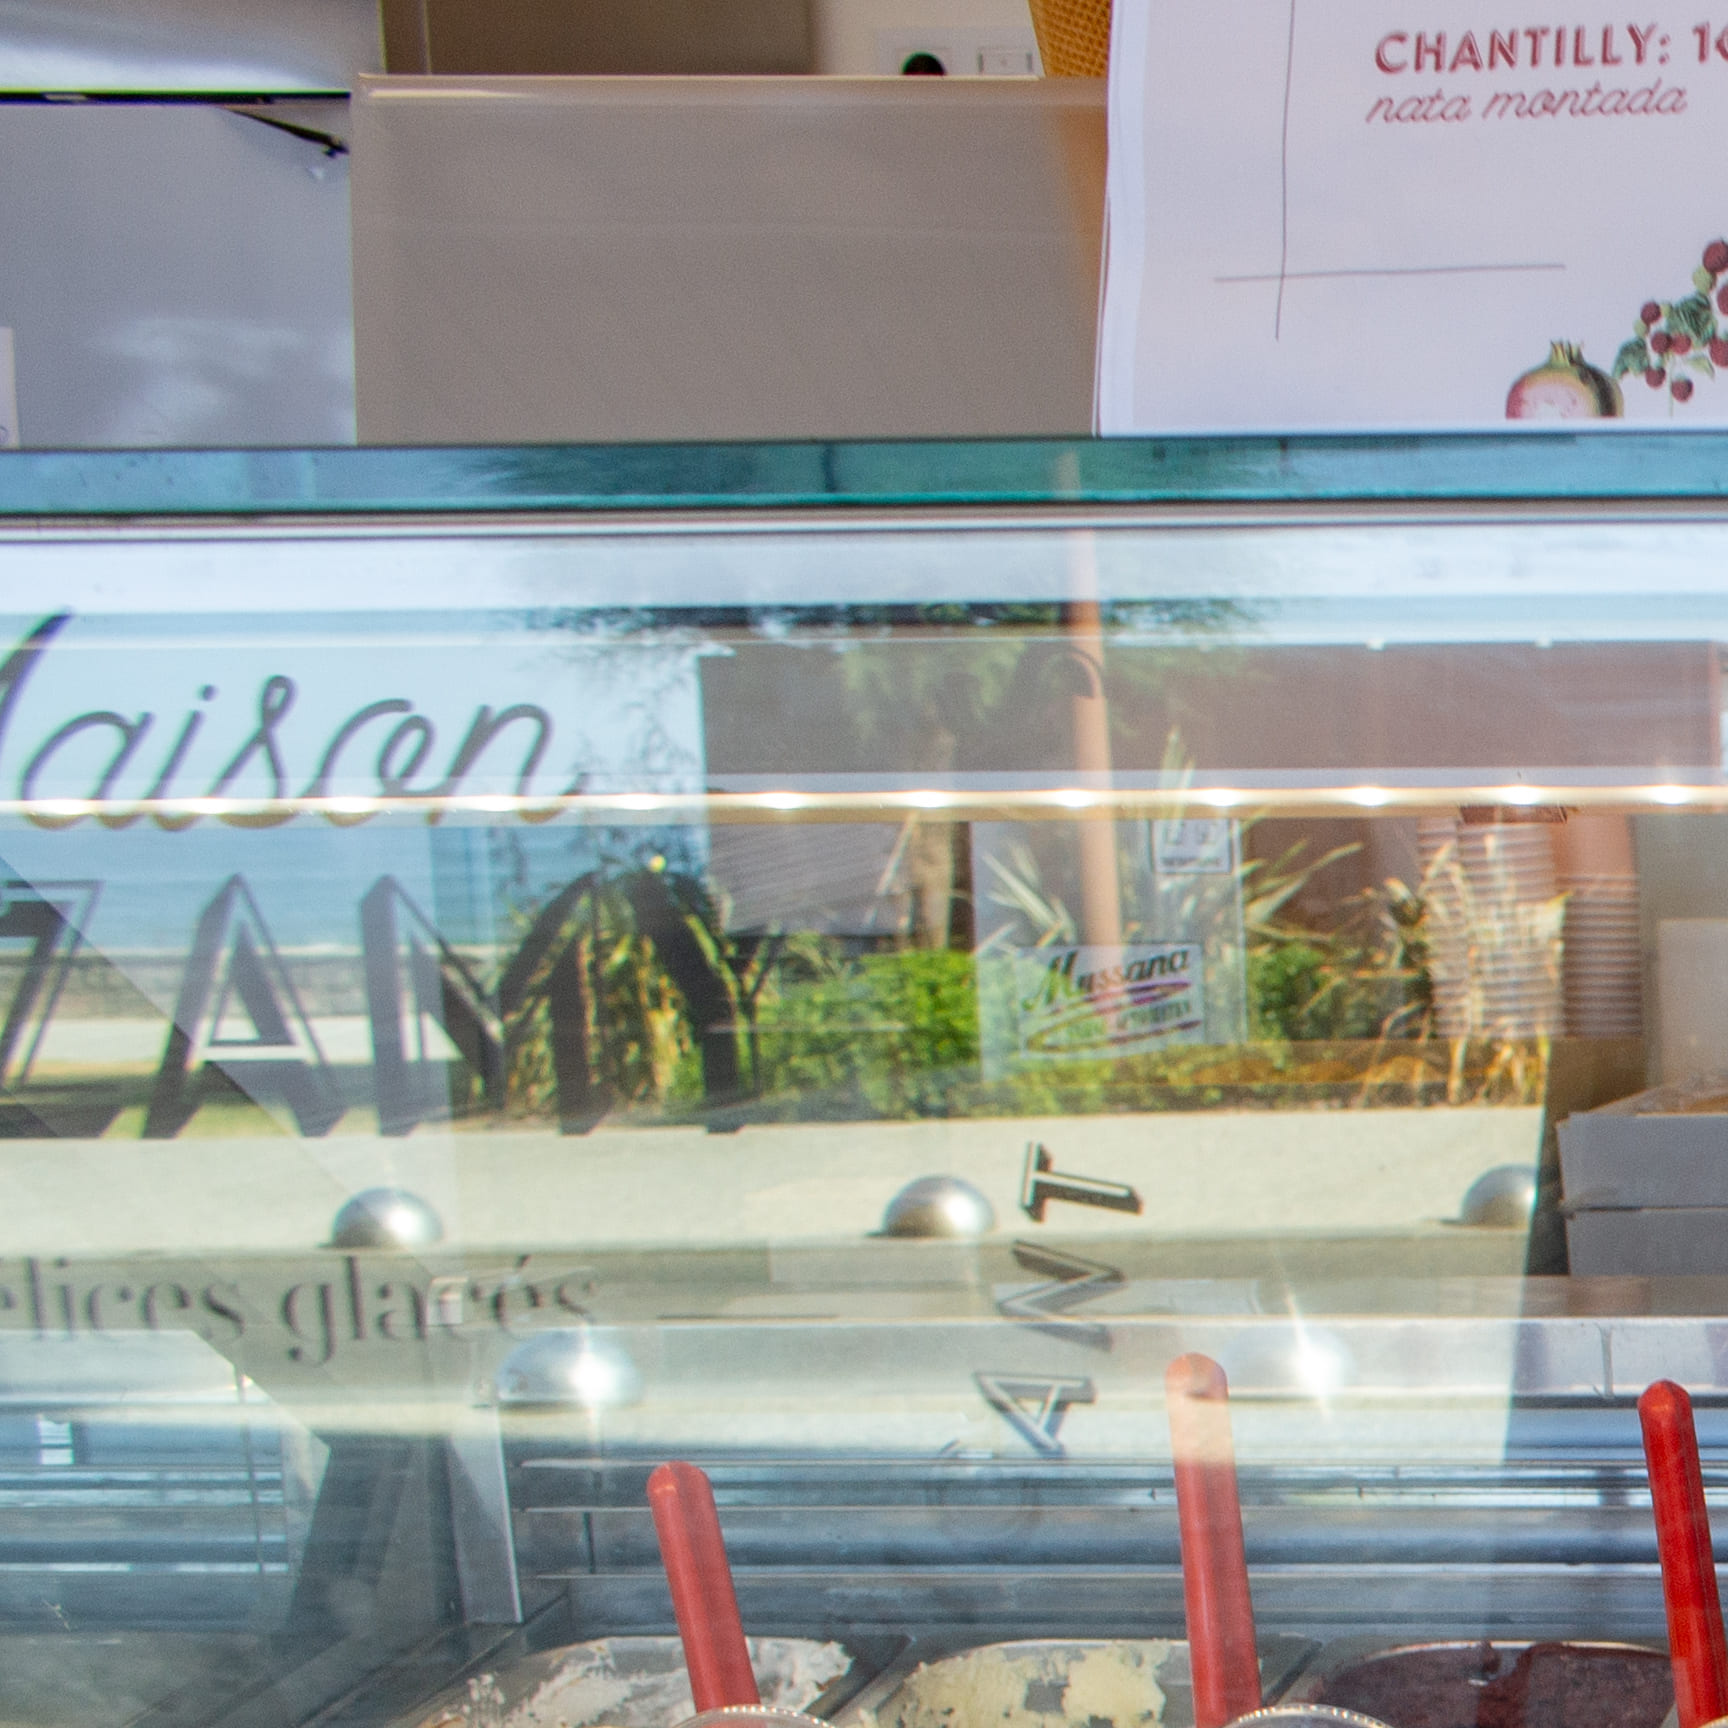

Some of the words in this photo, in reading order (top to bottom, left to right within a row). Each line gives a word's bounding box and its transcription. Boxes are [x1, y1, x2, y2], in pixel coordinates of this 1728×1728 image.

[1374, 22, 1671, 74] CHANTILLY:
[1366, 88, 1473, 124] nata
[1481, 77, 1690, 121] montada
